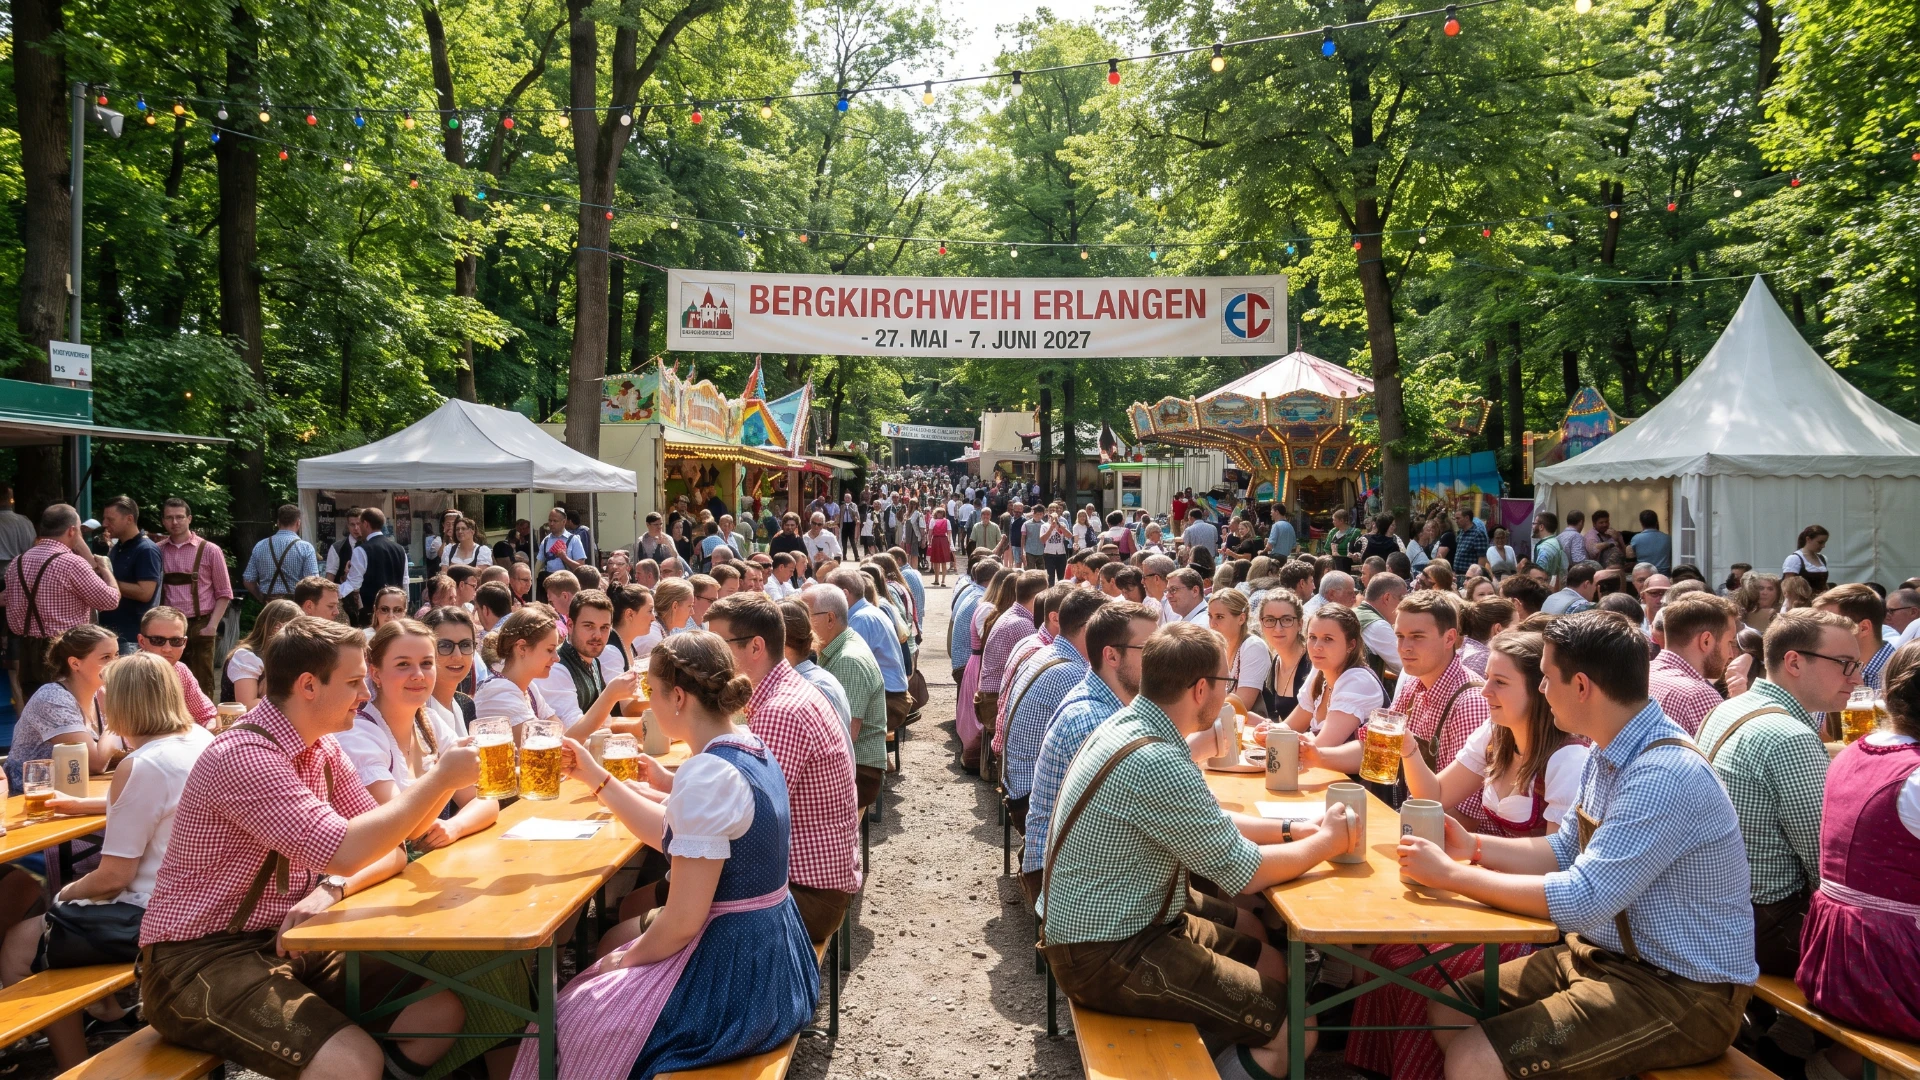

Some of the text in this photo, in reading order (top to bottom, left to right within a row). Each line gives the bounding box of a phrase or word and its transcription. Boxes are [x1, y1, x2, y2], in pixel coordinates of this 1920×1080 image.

[750, 285, 1206, 319] BERGKIRCHWEIH ERLANGEN
[875, 328, 904, 348] 27.
[910, 329, 948, 349] MAI
[969, 330, 986, 349] 7.
[991, 330, 1037, 349] JUNI
[1043, 330, 1092, 349] 2027
